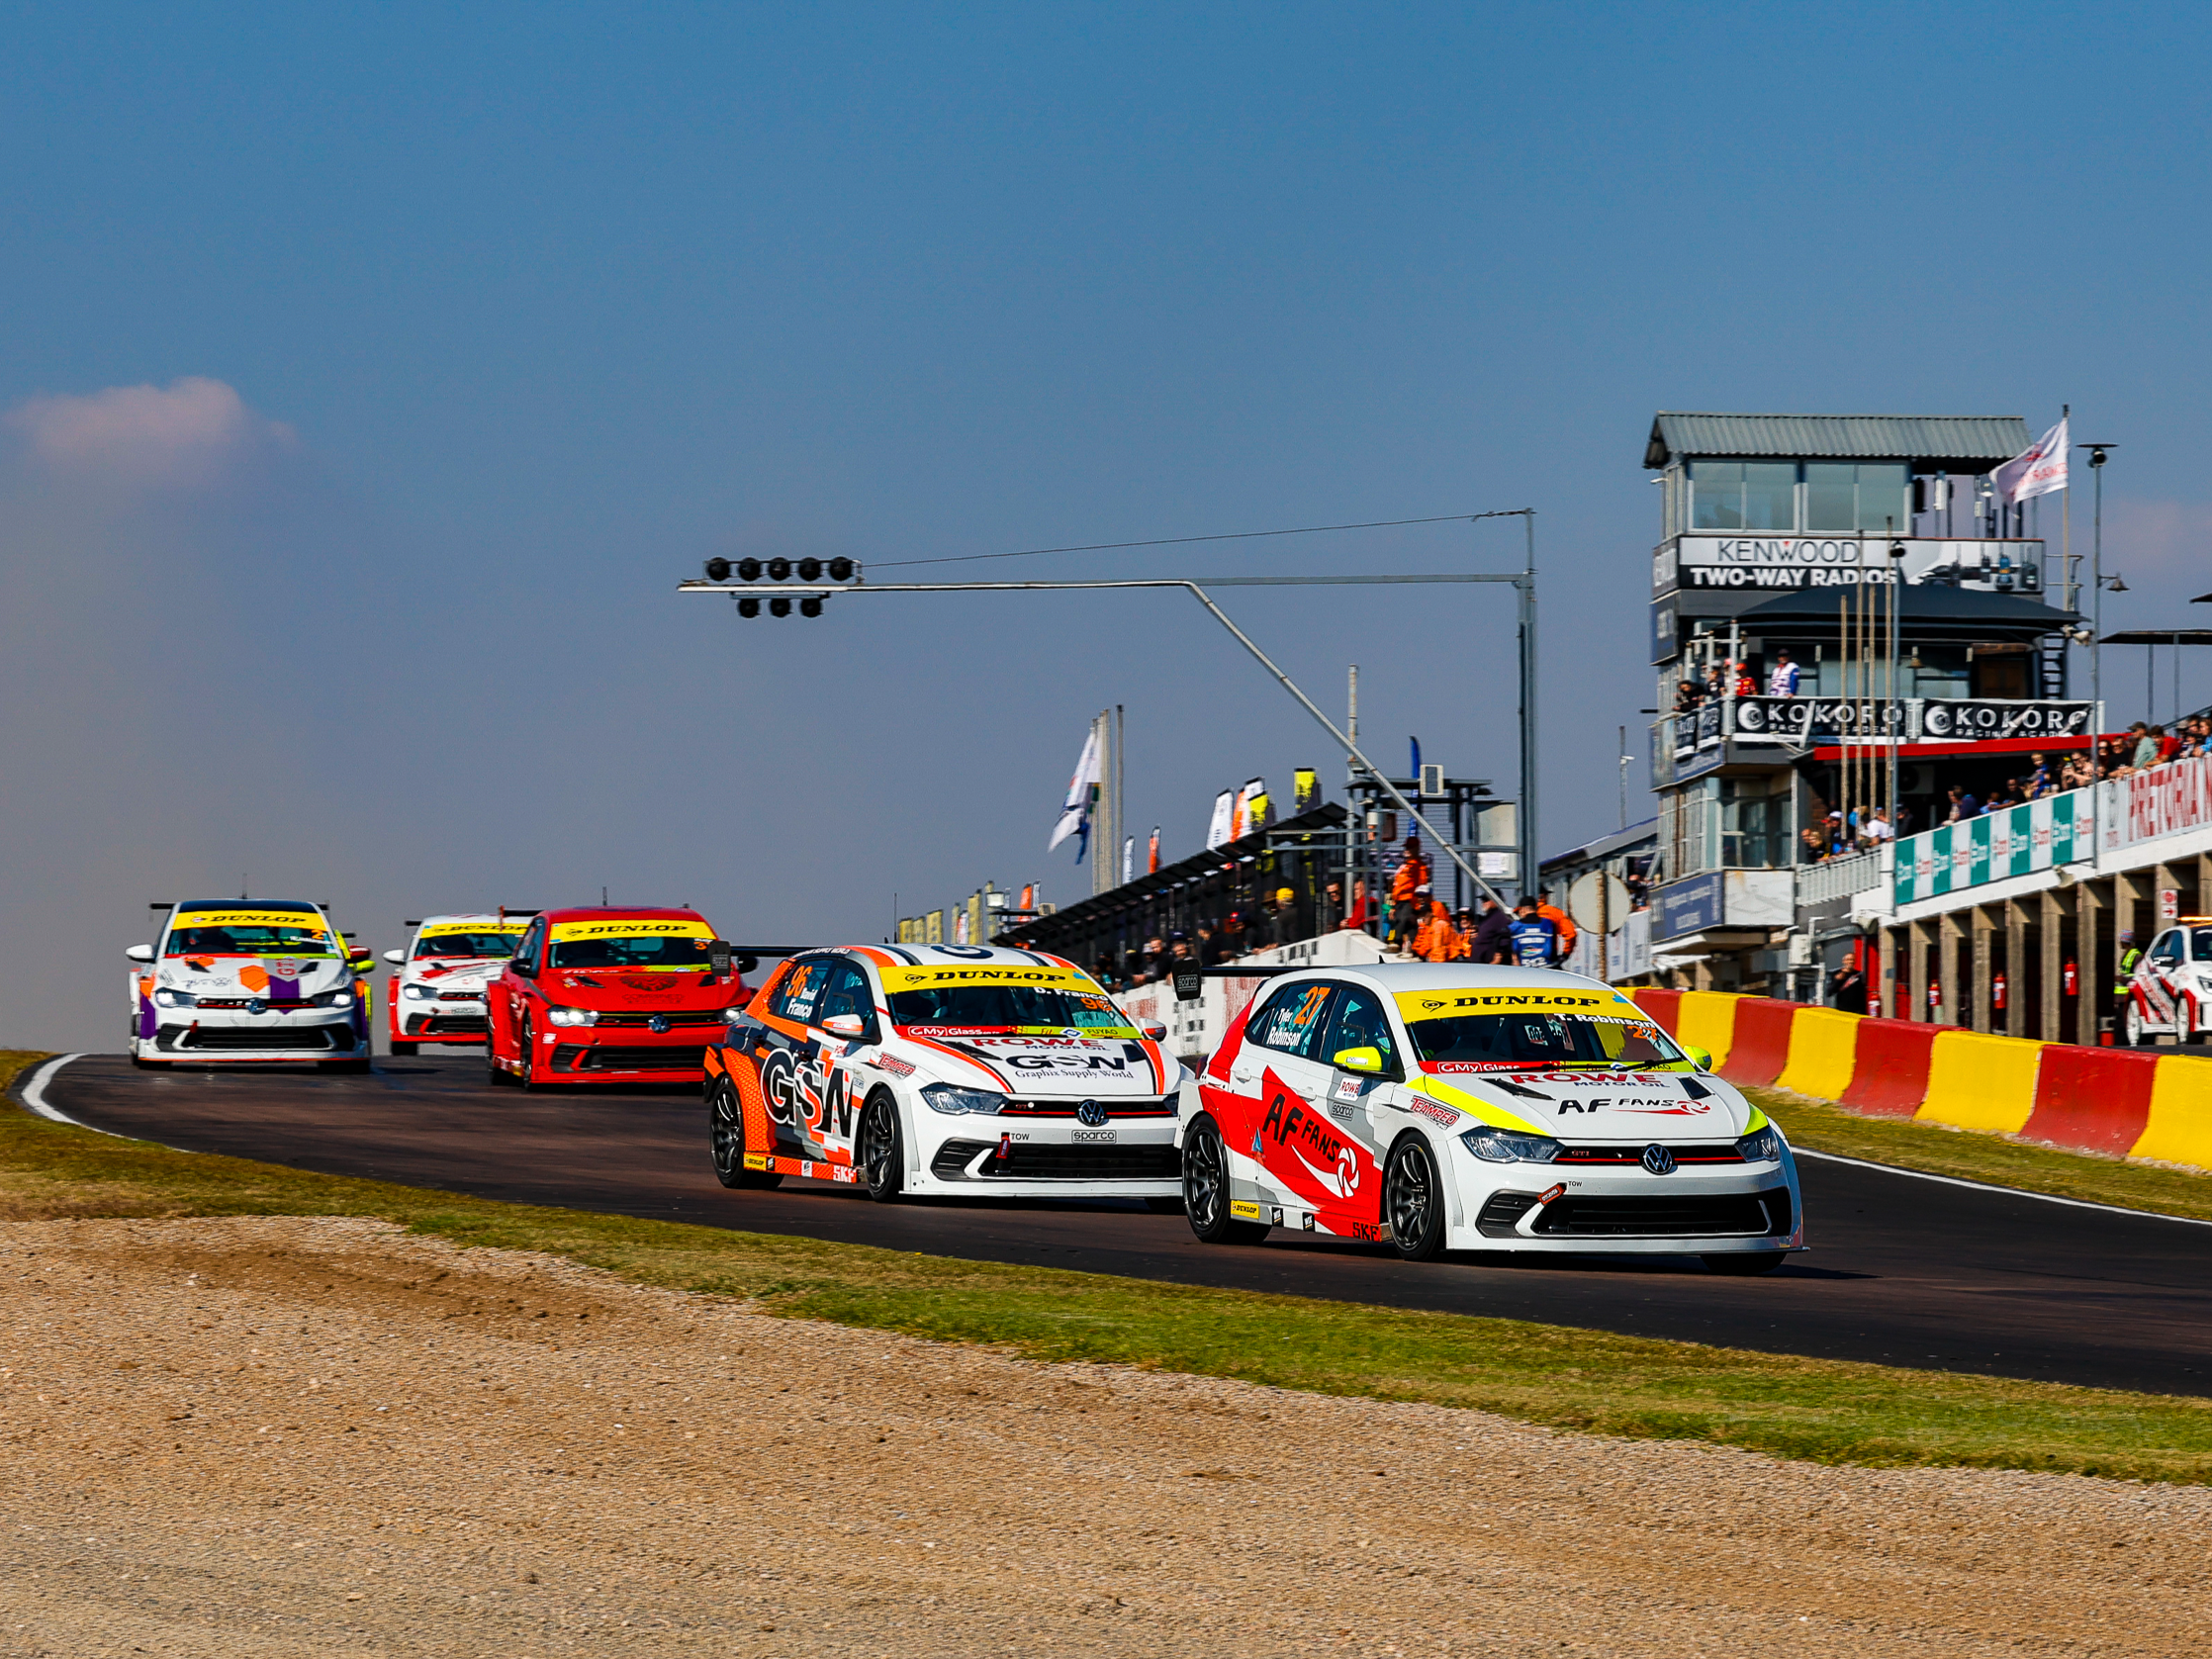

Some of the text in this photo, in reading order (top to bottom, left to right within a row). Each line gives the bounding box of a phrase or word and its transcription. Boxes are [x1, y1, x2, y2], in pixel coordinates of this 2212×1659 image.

[1717, 540, 1860, 563] KENWOOD
[1690, 567, 1806, 586] TWO-WAY
[1809, 568, 1897, 587] RADIOS
[1768, 703, 1902, 724] KOKORO
[1955, 707, 2087, 729] KOKORO
[209, 914, 307, 924] DUNLOP
[785, 965, 813, 997] 96
[933, 971, 1065, 982] DUNLOP
[1054, 988, 1109, 1001] Franco
[1453, 995, 1601, 1007] DUNLOP
[786, 997, 813, 1018] Franco
[1080, 997, 1113, 1012] 96
[1293, 985, 1332, 1025] 27
[1277, 1007, 1293, 1025] Tyler
[1577, 1014, 1656, 1029] Robinson
[1266, 1026, 1302, 1047] Robinson
[1626, 1025, 1658, 1041] 27
[971, 1039, 1104, 1048] ROWE
[1015, 1069, 1135, 1079] Graphix Supply World
[1508, 1072, 1662, 1084] ROWE
[1332, 1104, 1353, 1117] sparco
[1557, 1098, 1675, 1116] AF FANS
[1262, 1093, 1341, 1162] AF FANS
[1073, 1131, 1115, 1143] sparco
[1236, 1205, 1257, 1215] DUNLOP
[1352, 1221, 1380, 1242] SKF
